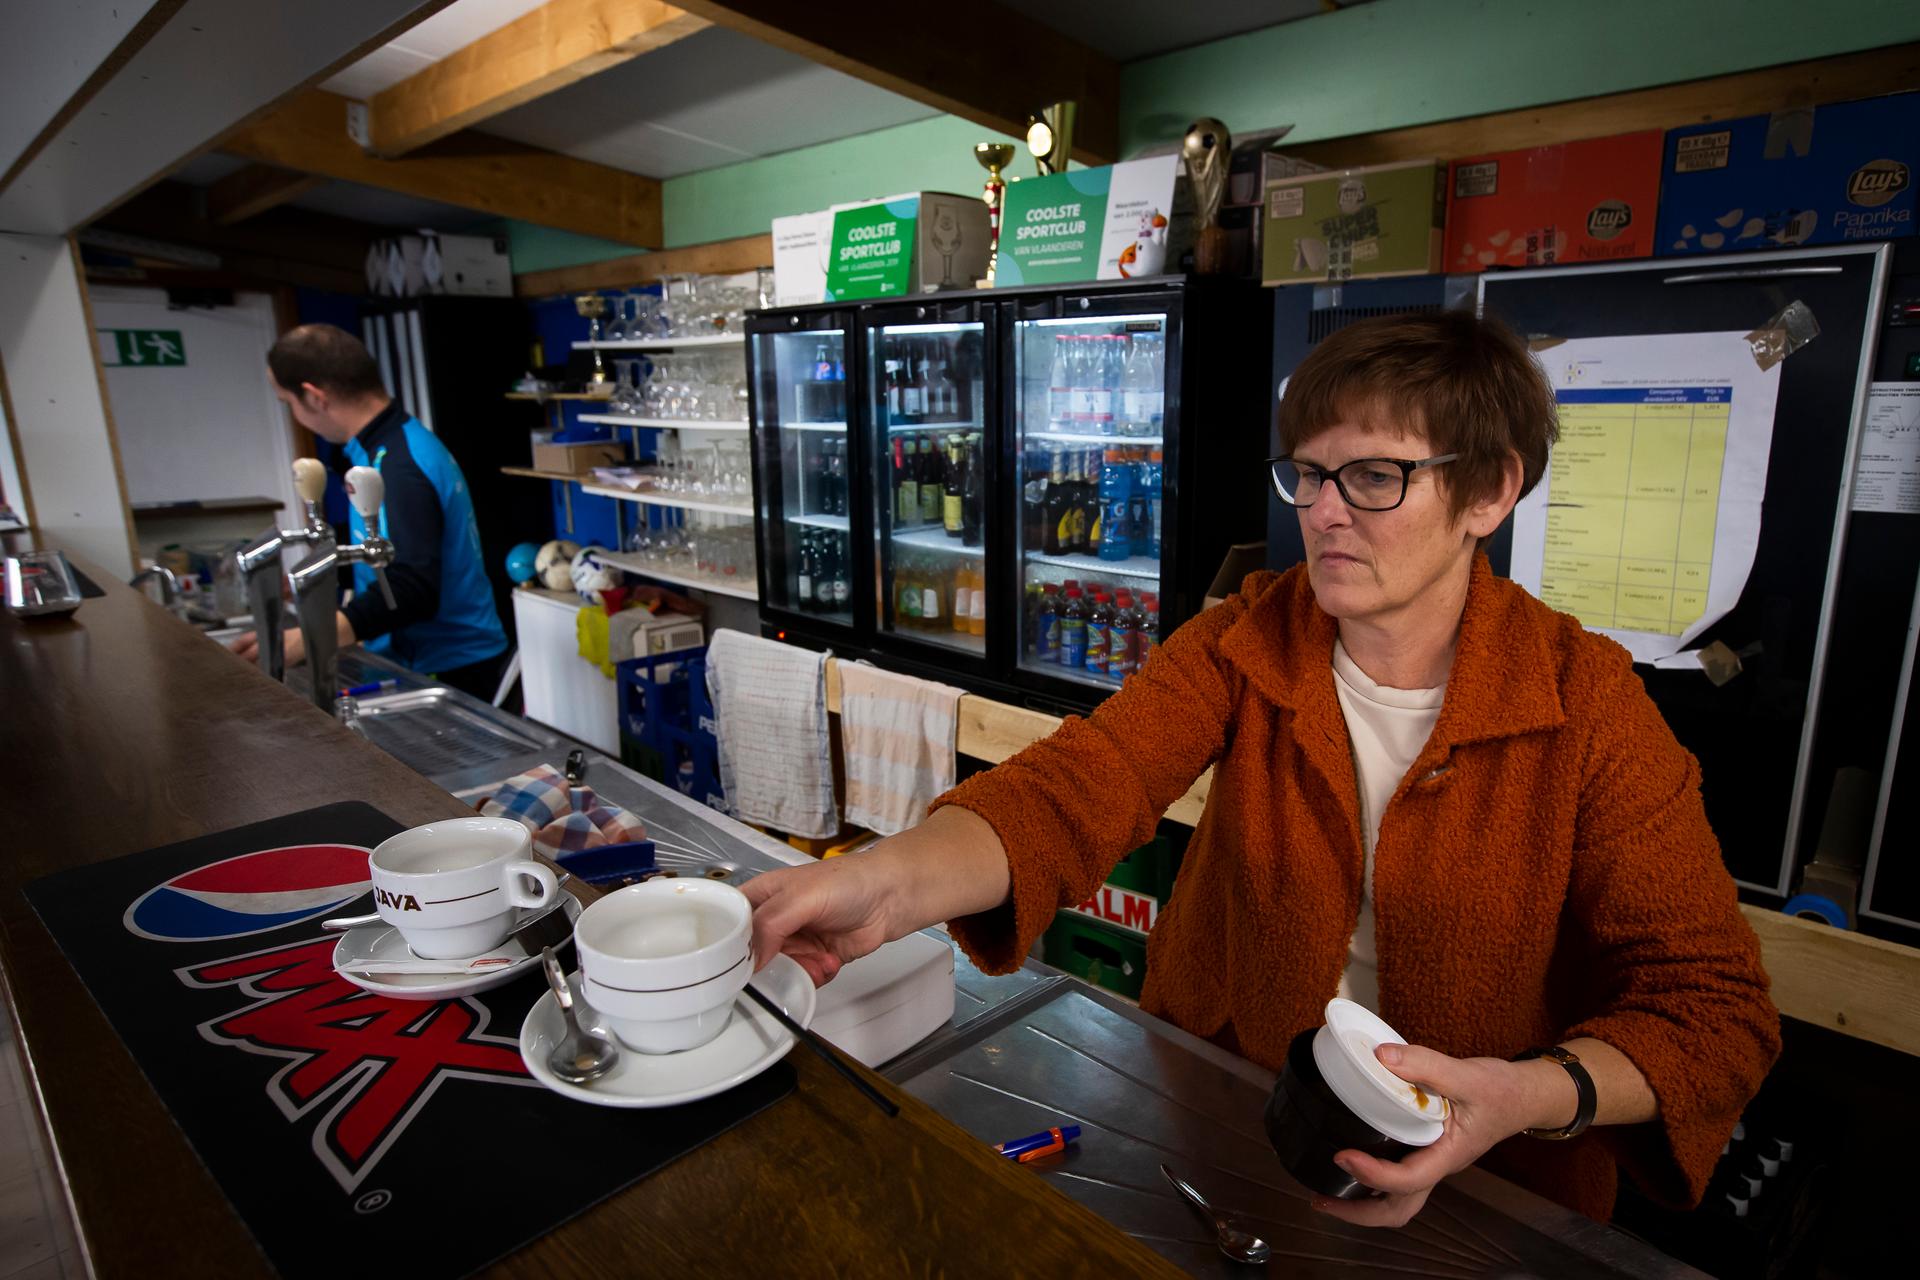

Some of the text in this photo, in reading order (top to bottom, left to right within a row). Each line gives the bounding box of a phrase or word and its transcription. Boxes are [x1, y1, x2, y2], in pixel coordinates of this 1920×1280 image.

[1851, 167, 1906, 195] Lay's
[1026, 203, 1082, 223] COOLSTE
[1589, 206, 1631, 230] Lay's
[1833, 207, 1911, 230] Paprika
[848, 221, 897, 243] COOLSTE
[1016, 220, 1087, 241] SPORTCLUB
[1843, 226, 1896, 240] Flavour
[839, 239, 902, 262] SPORTCLUB
[1031, 240, 1084, 255] VLAANDEREN
[375, 885, 423, 912] JAVA
[1078, 887, 1151, 932] ALM
